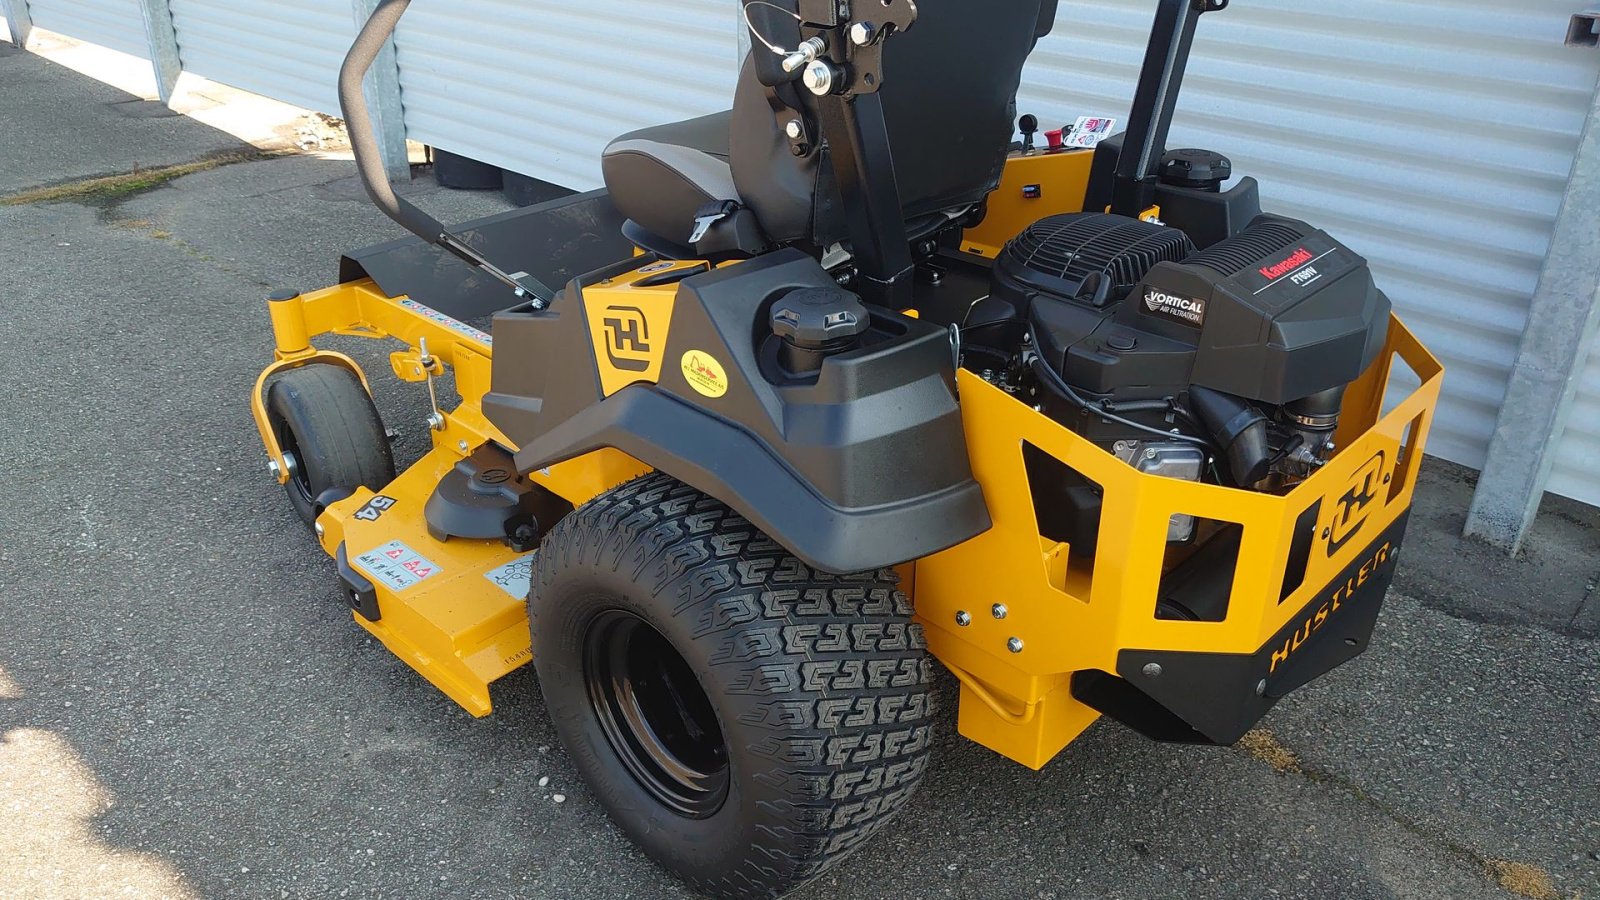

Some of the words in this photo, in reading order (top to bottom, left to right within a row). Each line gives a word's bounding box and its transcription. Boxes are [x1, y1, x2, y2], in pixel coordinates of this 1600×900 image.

[1259, 248, 1313, 280] Kawasaki
[1150, 291, 1202, 313] VORTICAL
[1160, 305, 1170, 313] AIR
[1170, 307, 1200, 322] FILTRATION
[353, 495, 398, 521] 54
[1269, 541, 1391, 673] HUSTLER
